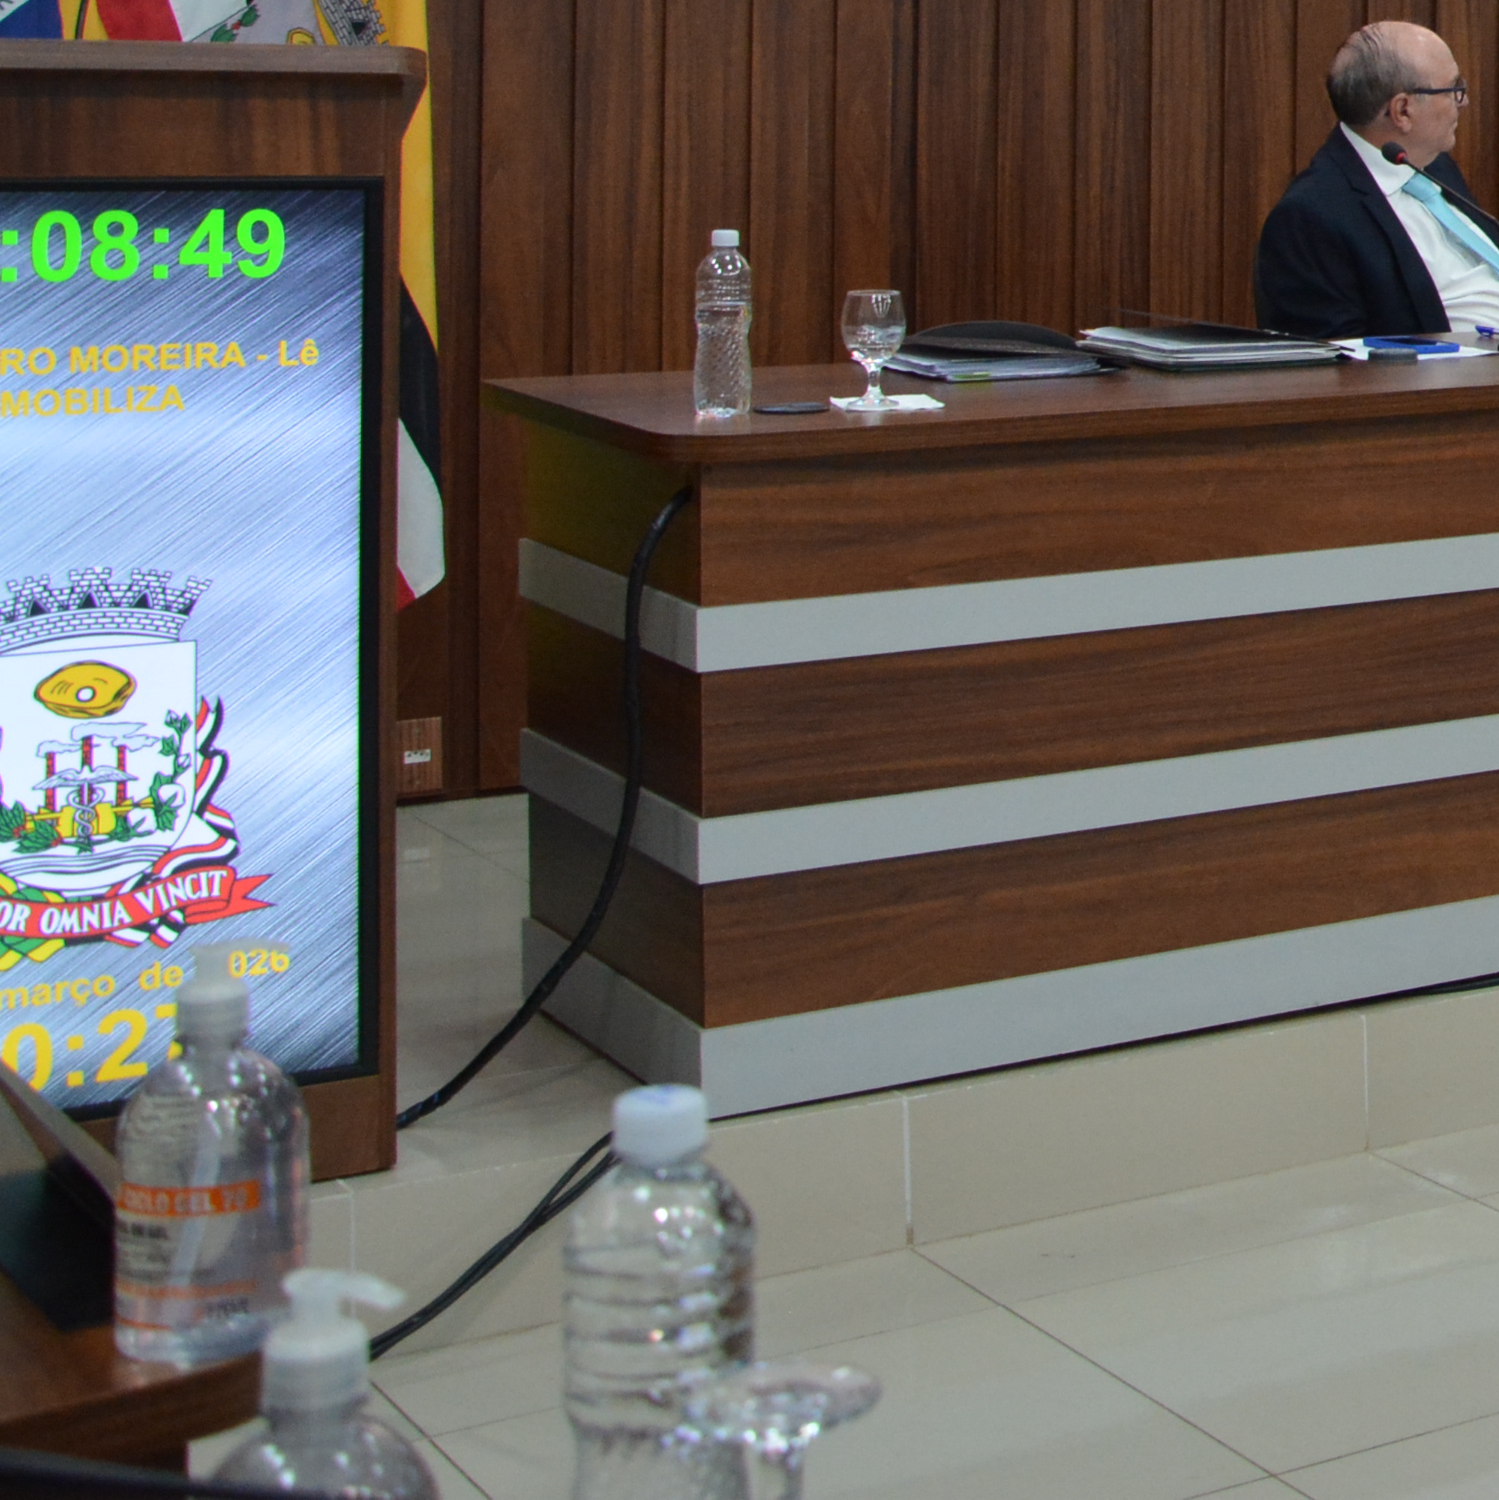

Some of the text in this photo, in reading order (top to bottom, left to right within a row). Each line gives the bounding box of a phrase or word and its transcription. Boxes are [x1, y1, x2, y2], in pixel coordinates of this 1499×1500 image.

[69, 342, 246, 373] MOREIRA
[278, 339, 319, 367] Lê
[0, 385, 185, 418] MOBILIZA
[39, 901, 132, 935] OMNIA
[134, 870, 228, 914] VINCIT
[0, 948, 290, 1009] março de 026
